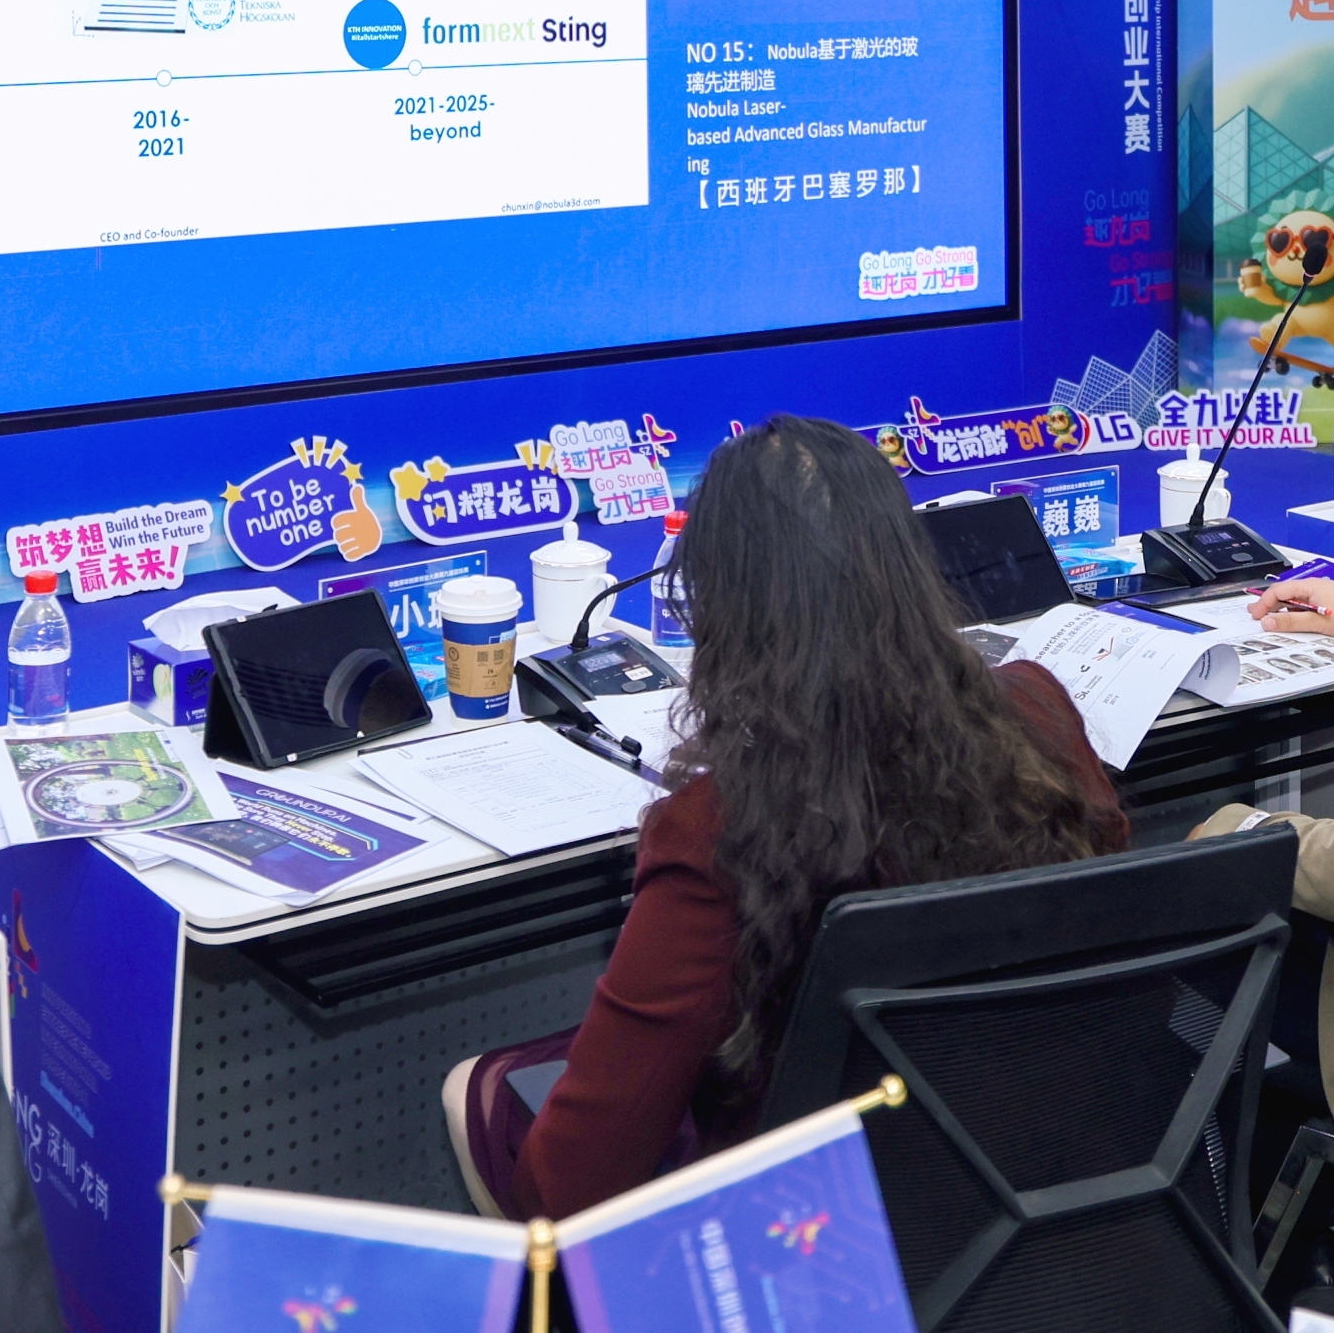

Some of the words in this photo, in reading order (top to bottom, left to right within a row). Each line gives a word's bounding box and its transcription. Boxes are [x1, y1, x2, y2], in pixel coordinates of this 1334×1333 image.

[422, 16, 536, 45] formnext
[541, 16, 607, 48] Sting
[686, 42, 717, 64] NO
[686, 68, 776, 94] 璃先进制造
[393, 94, 496, 116] 2021-2025-
[687, 100, 739, 119] Nobula
[743, 99, 787, 116] Laser-
[132, 109, 190, 131] 2016-
[687, 126, 731, 146] based
[734, 121, 805, 143] Advanced
[807, 120, 845, 139] Glass
[847, 117, 928, 137] Manufactur
[409, 121, 482, 144] beyond
[137, 137, 185, 159] 2021
[687, 156, 710, 175] ing
[99, 230, 121, 243] CEO
[123, 228, 142, 241] and
[144, 225, 199, 240] Co-founder
[862, 256, 880, 270] Go
[882, 254, 913, 271] Long
[915, 250, 932, 266] Go
[934, 248, 975, 265] Strong
[555, 430, 579, 447] Go
[582, 423, 626, 443] Long
[1095, 414, 1136, 443] LG
[1148, 428, 1191, 448] GIVE
[1195, 427, 1214, 446] IT
[1218, 426, 1277, 446] YOUR
[1280, 425, 1314, 445] ALL
[594, 477, 615, 493] Go
[616, 470, 664, 492] Strong
[250, 487, 283, 512] To
[289, 477, 322, 502] be
[105, 516, 139, 535] Build
[141, 513, 163, 529] the
[165, 504, 207, 524] Dream
[245, 492, 335, 537] number
[15, 521, 107, 569] 筑梦想
[108, 533, 137, 550] Win
[139, 529, 160, 546] the
[162, 522, 205, 542] Future
[279, 522, 324, 546] one
